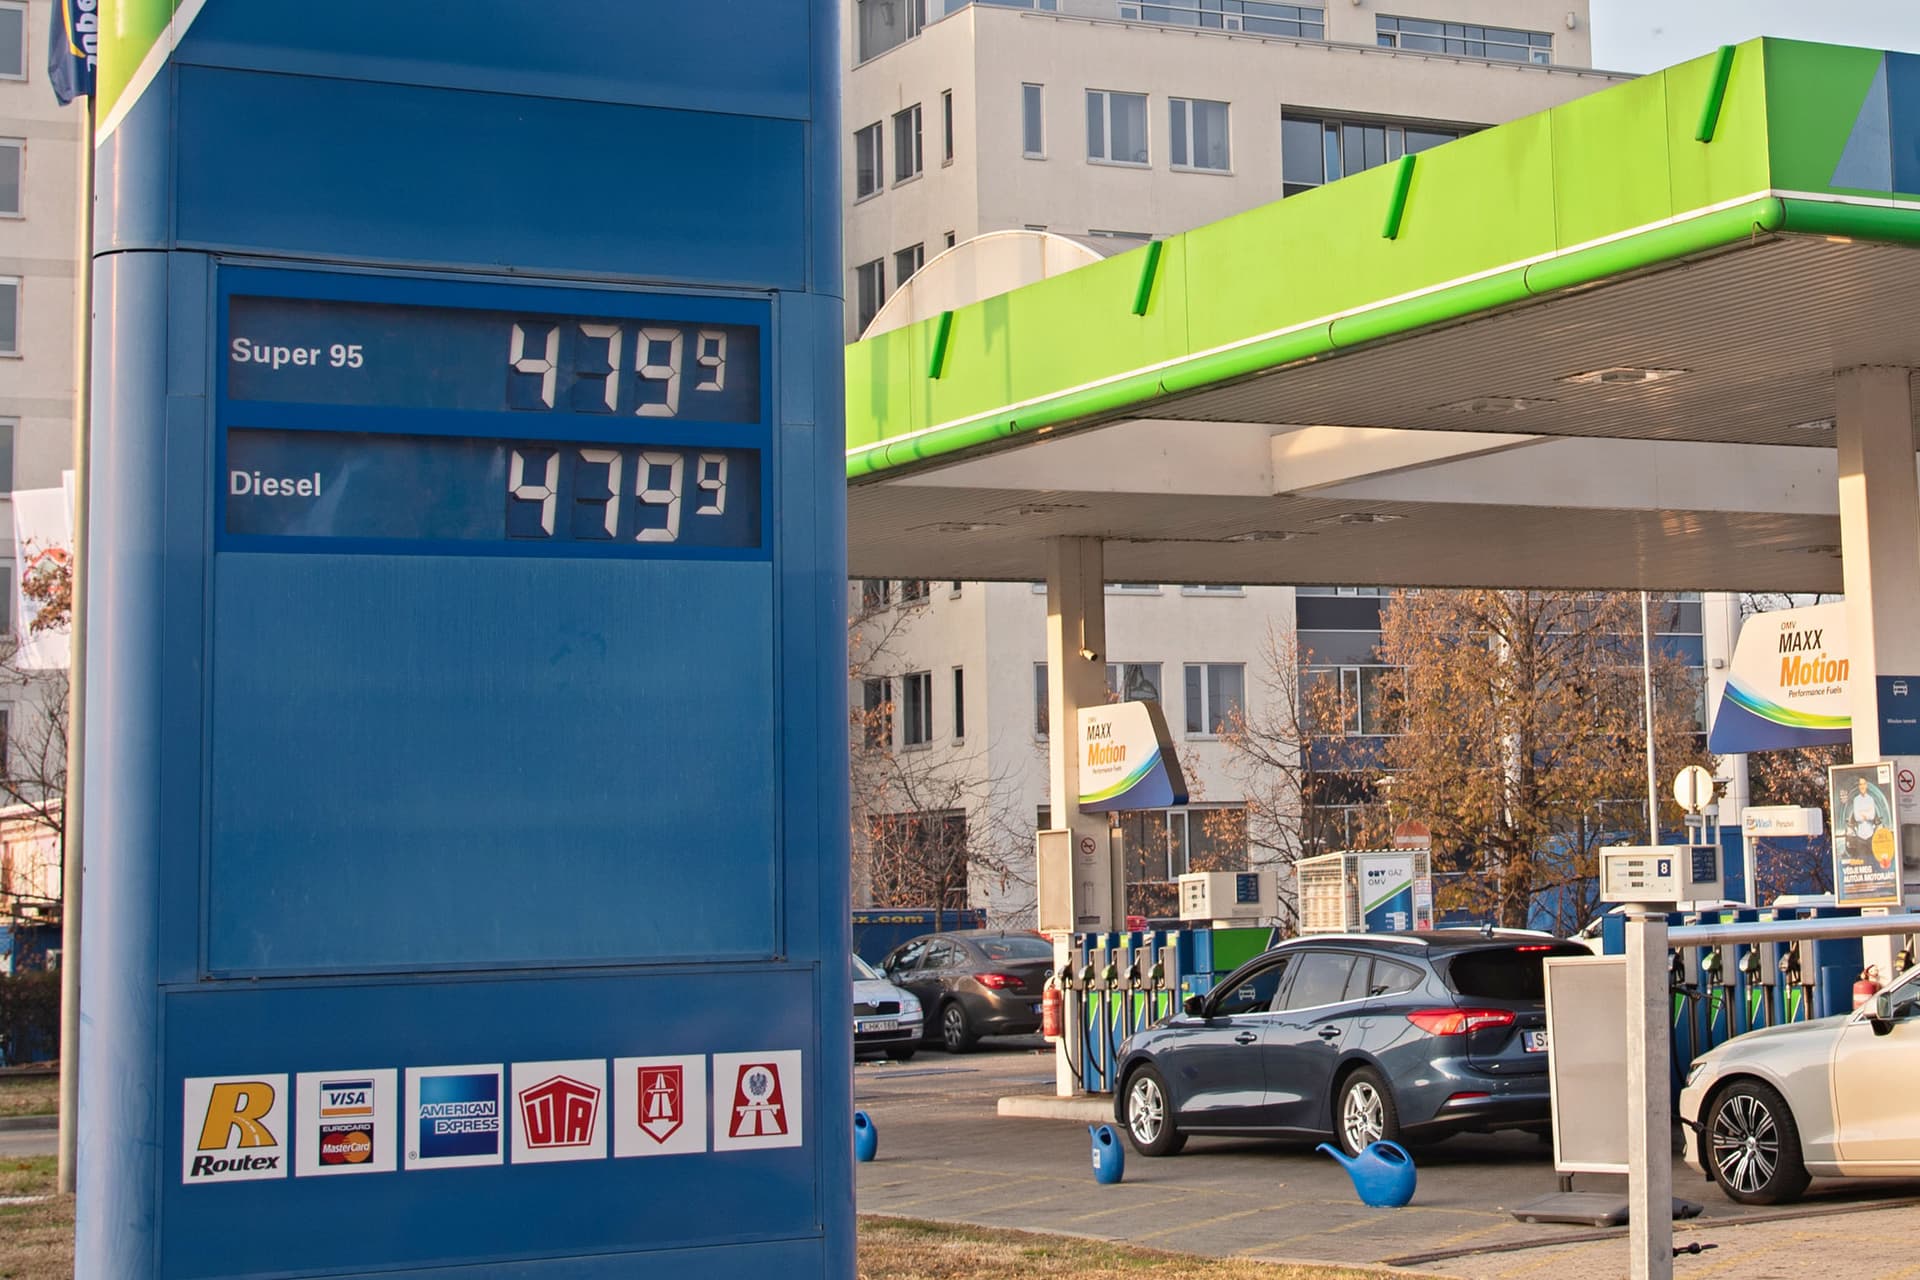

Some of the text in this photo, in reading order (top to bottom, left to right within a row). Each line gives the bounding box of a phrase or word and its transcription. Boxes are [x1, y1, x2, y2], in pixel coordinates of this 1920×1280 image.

[231, 337, 321, 370] Super
[329, 344, 364, 368] 95
[230, 470, 321, 497] Diesel
[1780, 621, 1797, 631] OMV
[1779, 629, 1823, 654] MAXX
[1780, 652, 1849, 687] Motion
[1788, 686, 1842, 698] Performance Fuels
[1086, 722, 1112, 741] MAXX
[1087, 740, 1126, 767] Motion
[1660, 862, 1668, 874] 8
[330, 1091, 366, 1106] VISA
[420, 1101, 496, 1118] AMERICAN
[522, 1078, 597, 1145] UTA
[322, 1123, 371, 1132] EUROCARD
[435, 1118, 500, 1134] EXPRESS
[322, 1140, 371, 1154] MasterCard
[190, 1155, 280, 1177] Routex
